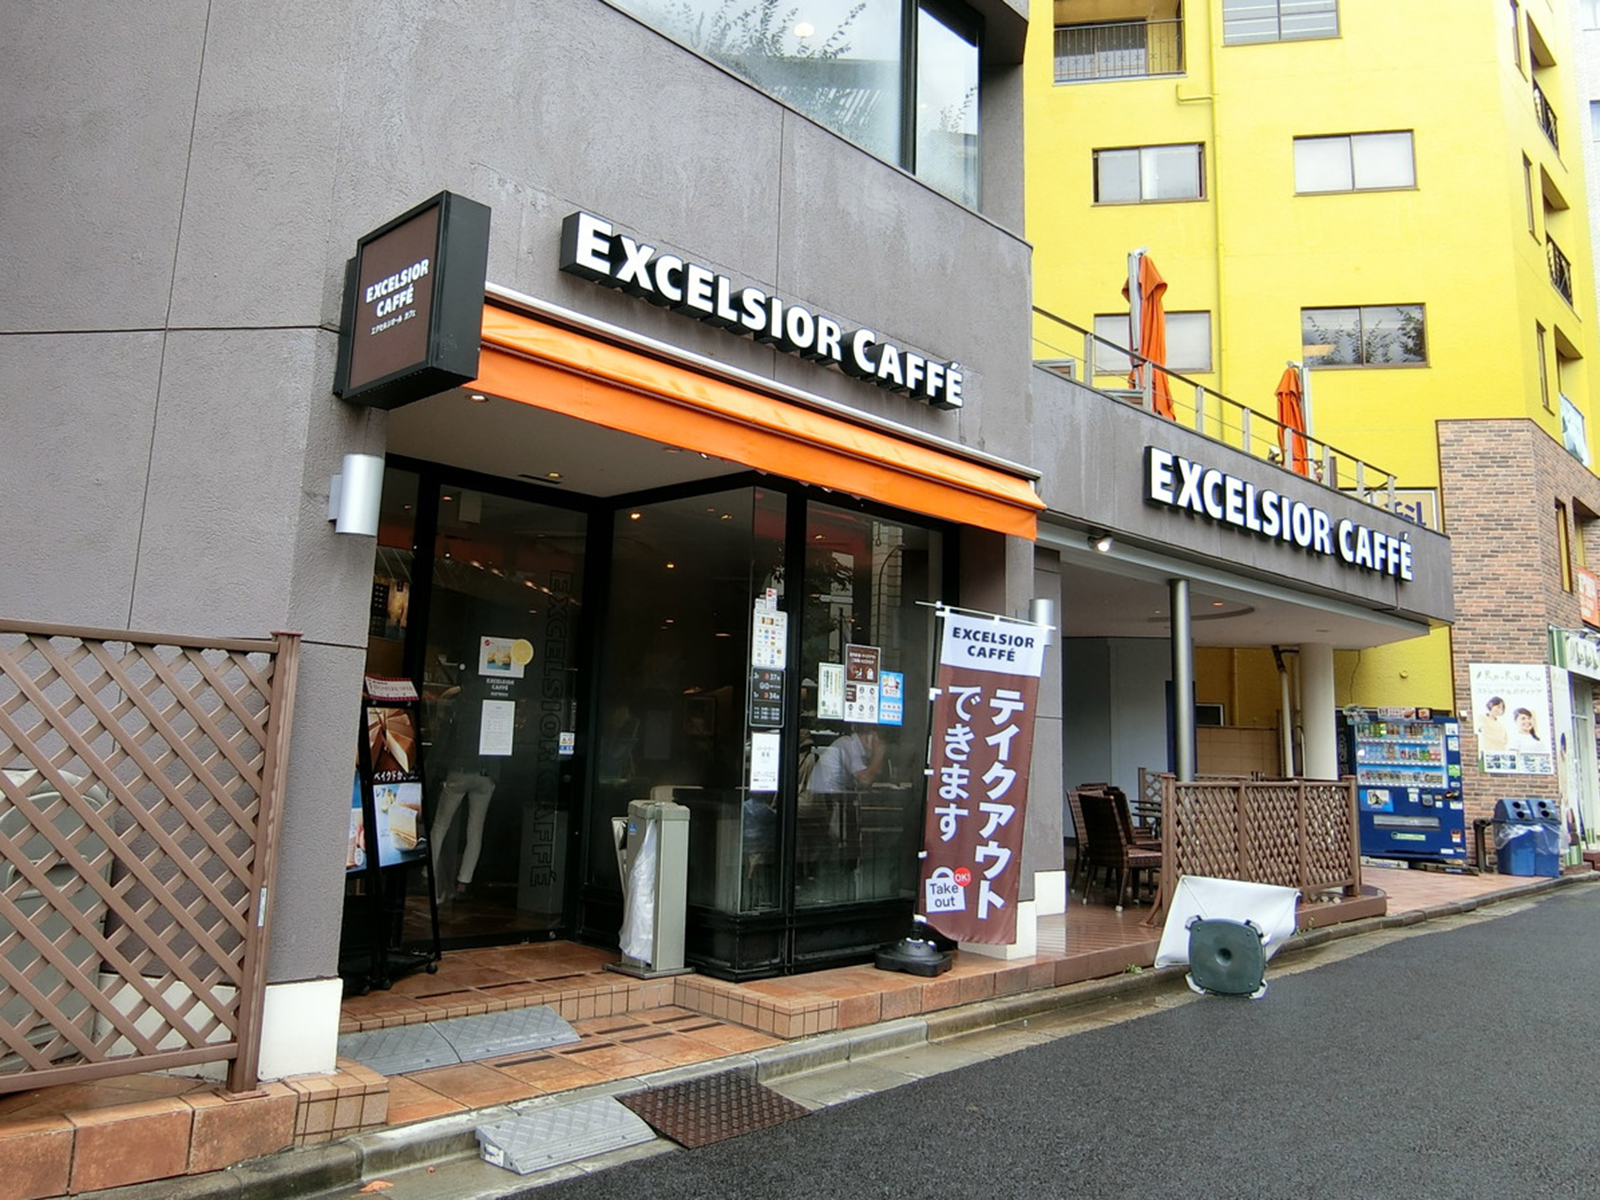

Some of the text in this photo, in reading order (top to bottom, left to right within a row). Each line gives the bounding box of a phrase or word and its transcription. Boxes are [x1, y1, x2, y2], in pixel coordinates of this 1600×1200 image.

[366, 258, 430, 303] EXCELSIOR
[376, 283, 415, 318] CAFFÉ
[575, 211, 964, 409] EXCELSIOR CAFFÉ
[1150, 446, 1414, 582] EXCELSIOR CAFFÉ
[952, 626, 1035, 649] EXCELSIOR
[966, 644, 1016, 663] CAFFÉ
[933, 685, 982, 843] できます
[974, 688, 1026, 920] テイクアウト
[929, 881, 959, 895] Take
[934, 895, 956, 908] out
